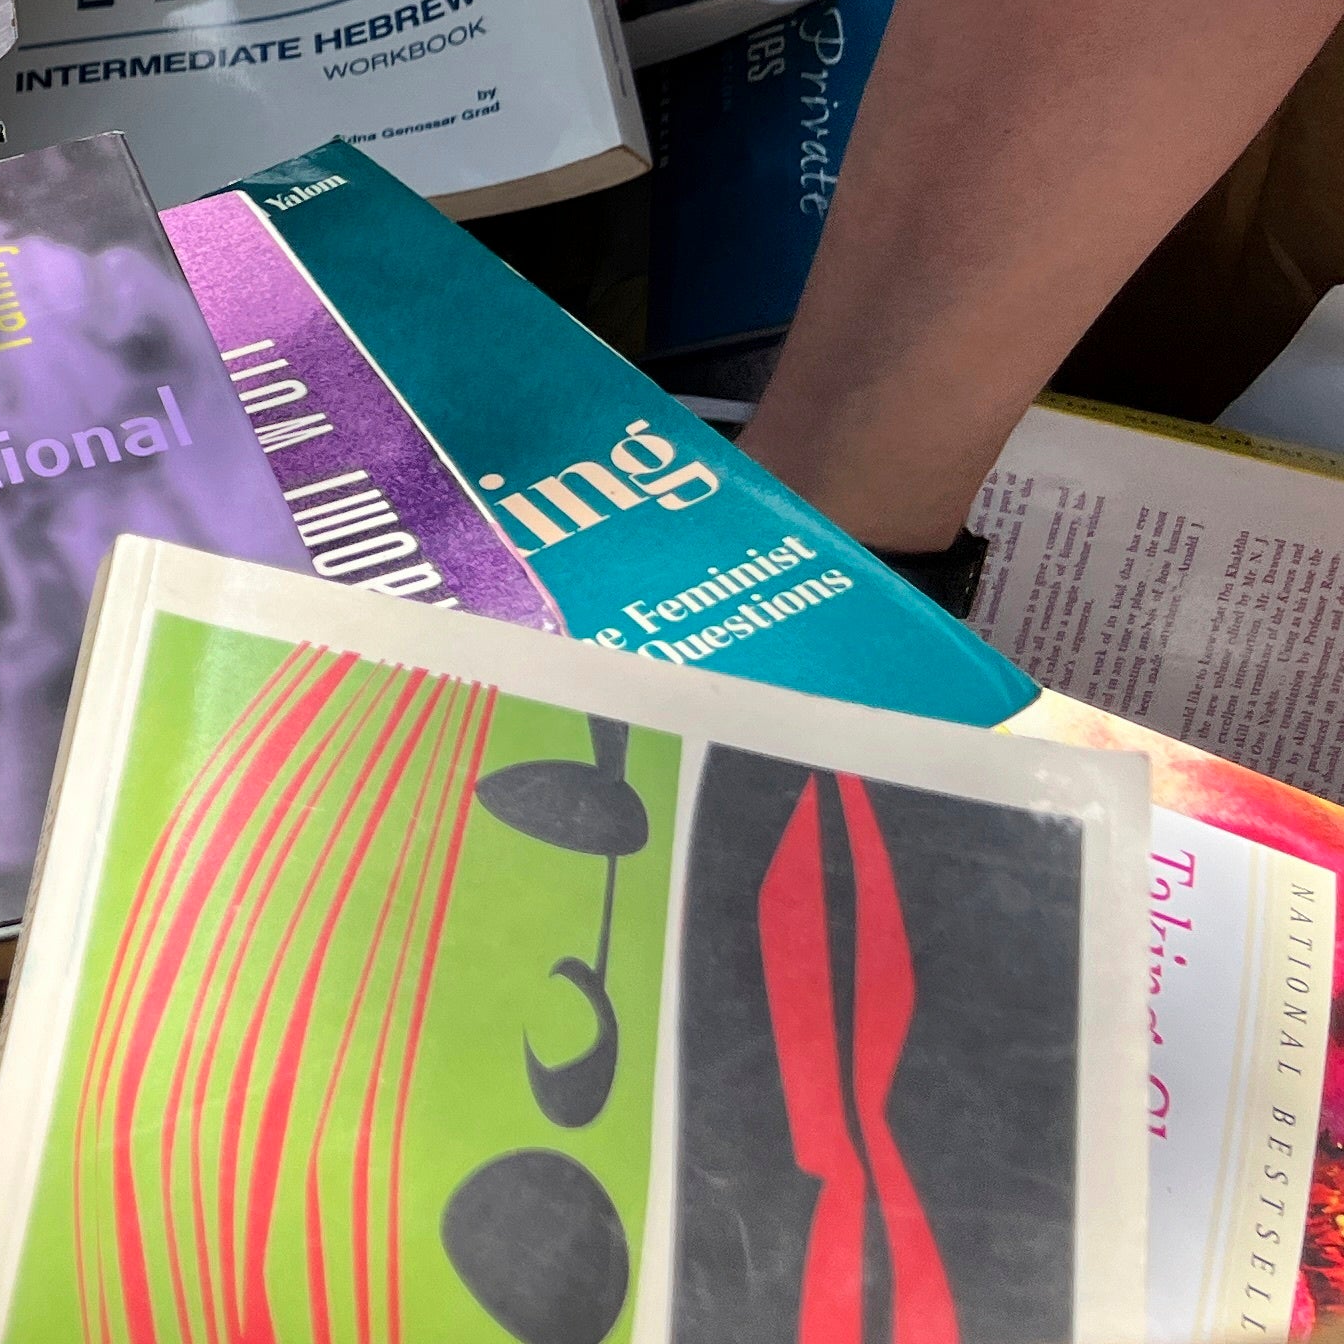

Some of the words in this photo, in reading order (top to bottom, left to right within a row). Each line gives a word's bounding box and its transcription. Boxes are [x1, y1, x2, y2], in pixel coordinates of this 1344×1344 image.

[11, 35, 303, 95] INTERMEDIATE
[322, 16, 488, 82] WORKBOOK
[476, 86, 497, 103] by
[381, 114, 457, 140] Genossar
[460, 100, 500, 120] Grad
[791, 5, 848, 218] Private
[262, 170, 348, 215] Yalom
[478, 421, 718, 558] ing
[619, 534, 817, 636] Feminist
[638, 565, 855, 668] Questions
[1275, 882, 1315, 1076] NATIONAL
[1239, 1106, 1297, 1333] BESTSELL
